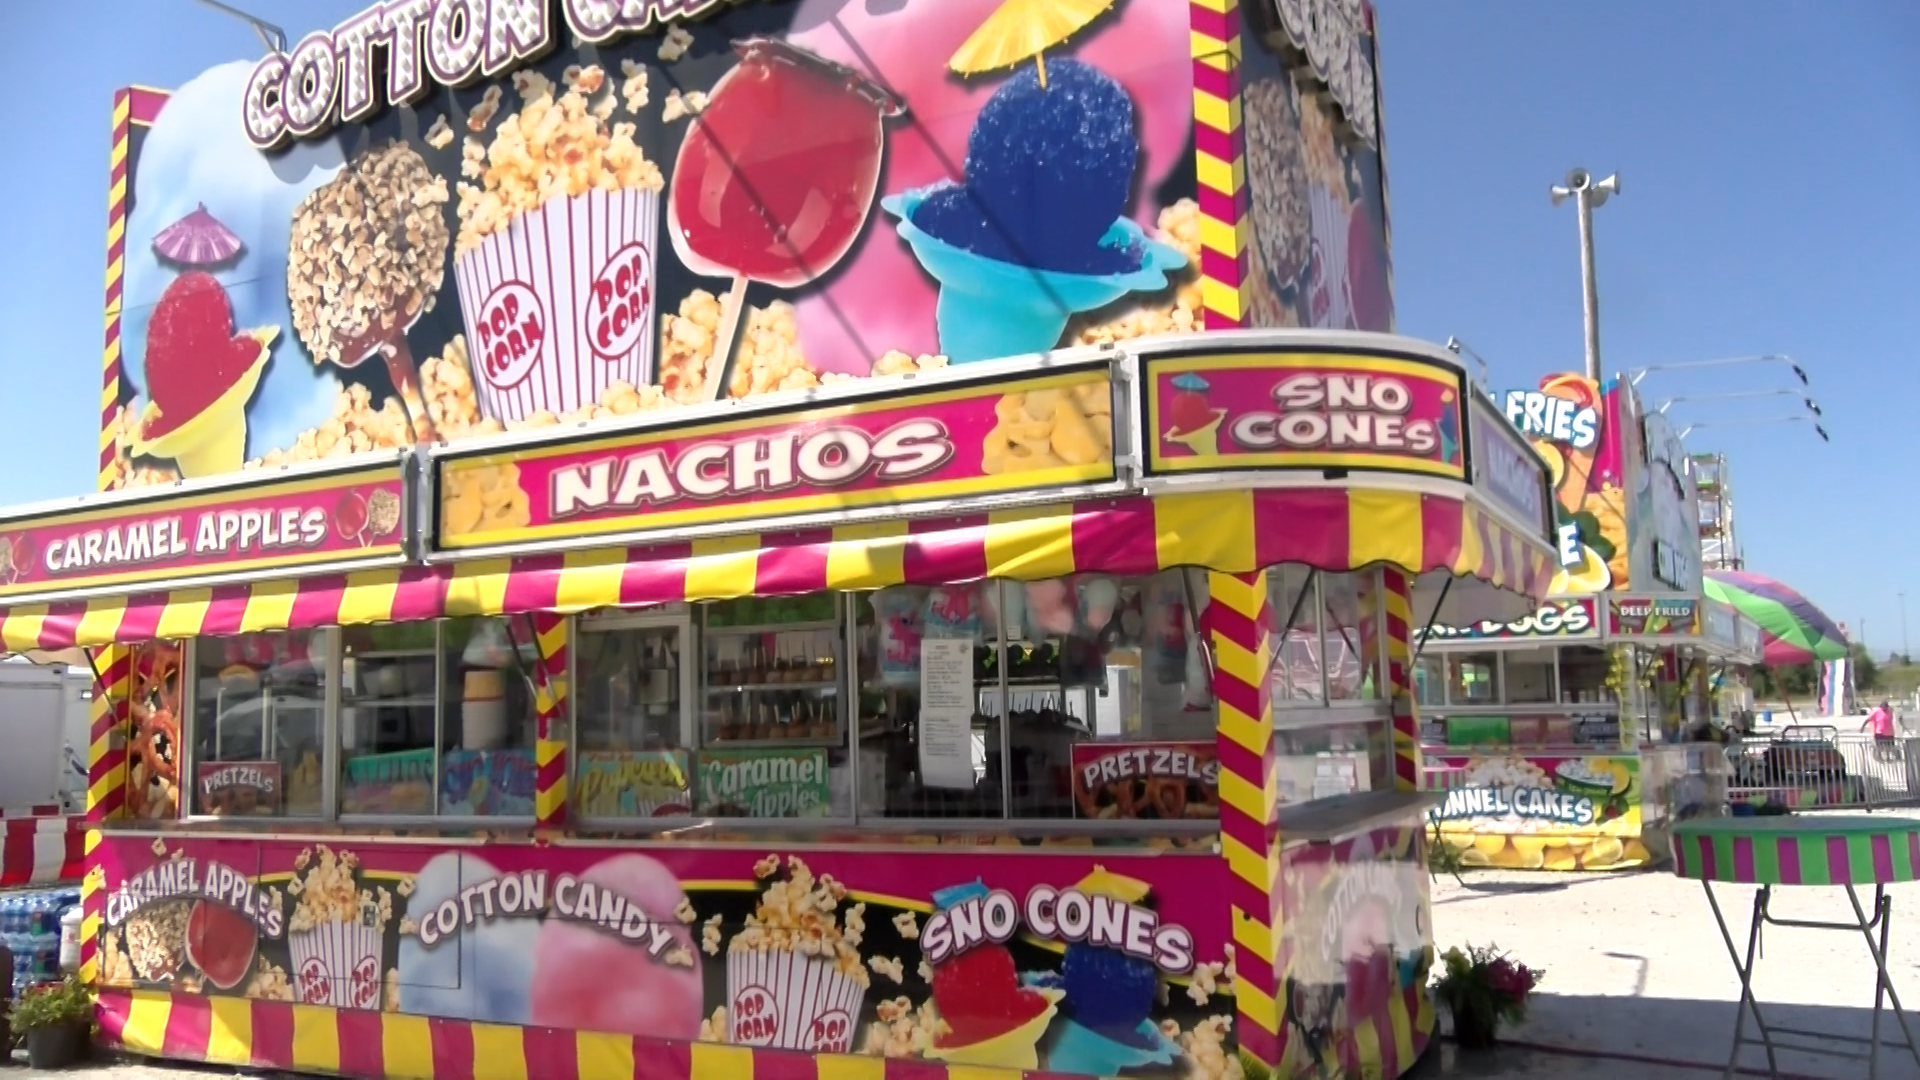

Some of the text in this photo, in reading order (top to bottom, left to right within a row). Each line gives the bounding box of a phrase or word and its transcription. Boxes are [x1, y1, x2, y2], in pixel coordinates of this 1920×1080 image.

[242, 0, 550, 148] COTTON
[595, 254, 641, 315] POP
[478, 293, 518, 349] POP
[486, 311, 542, 378] CORN
[1274, 374, 1410, 414] SNO
[1505, 390, 1597, 448] FRIES
[1232, 414, 1437, 452] CONES
[553, 420, 953, 516] NACHOS
[45, 509, 327, 572] CARAMEL APPLES
[204, 767, 274, 794] PRETZELS
[705, 754, 823, 803] Caramel
[1083, 750, 1220, 789] PRETZELS
[1513, 788, 1593, 823] CAKES
[106, 861, 283, 937] CARAMEL APPLES
[420, 871, 673, 956] COTTON CANDY
[922, 886, 1192, 970] SNO CONES
[734, 993, 764, 1019] POP
[736, 1013, 775, 1040] CORN
[813, 1019, 846, 1041] POP
